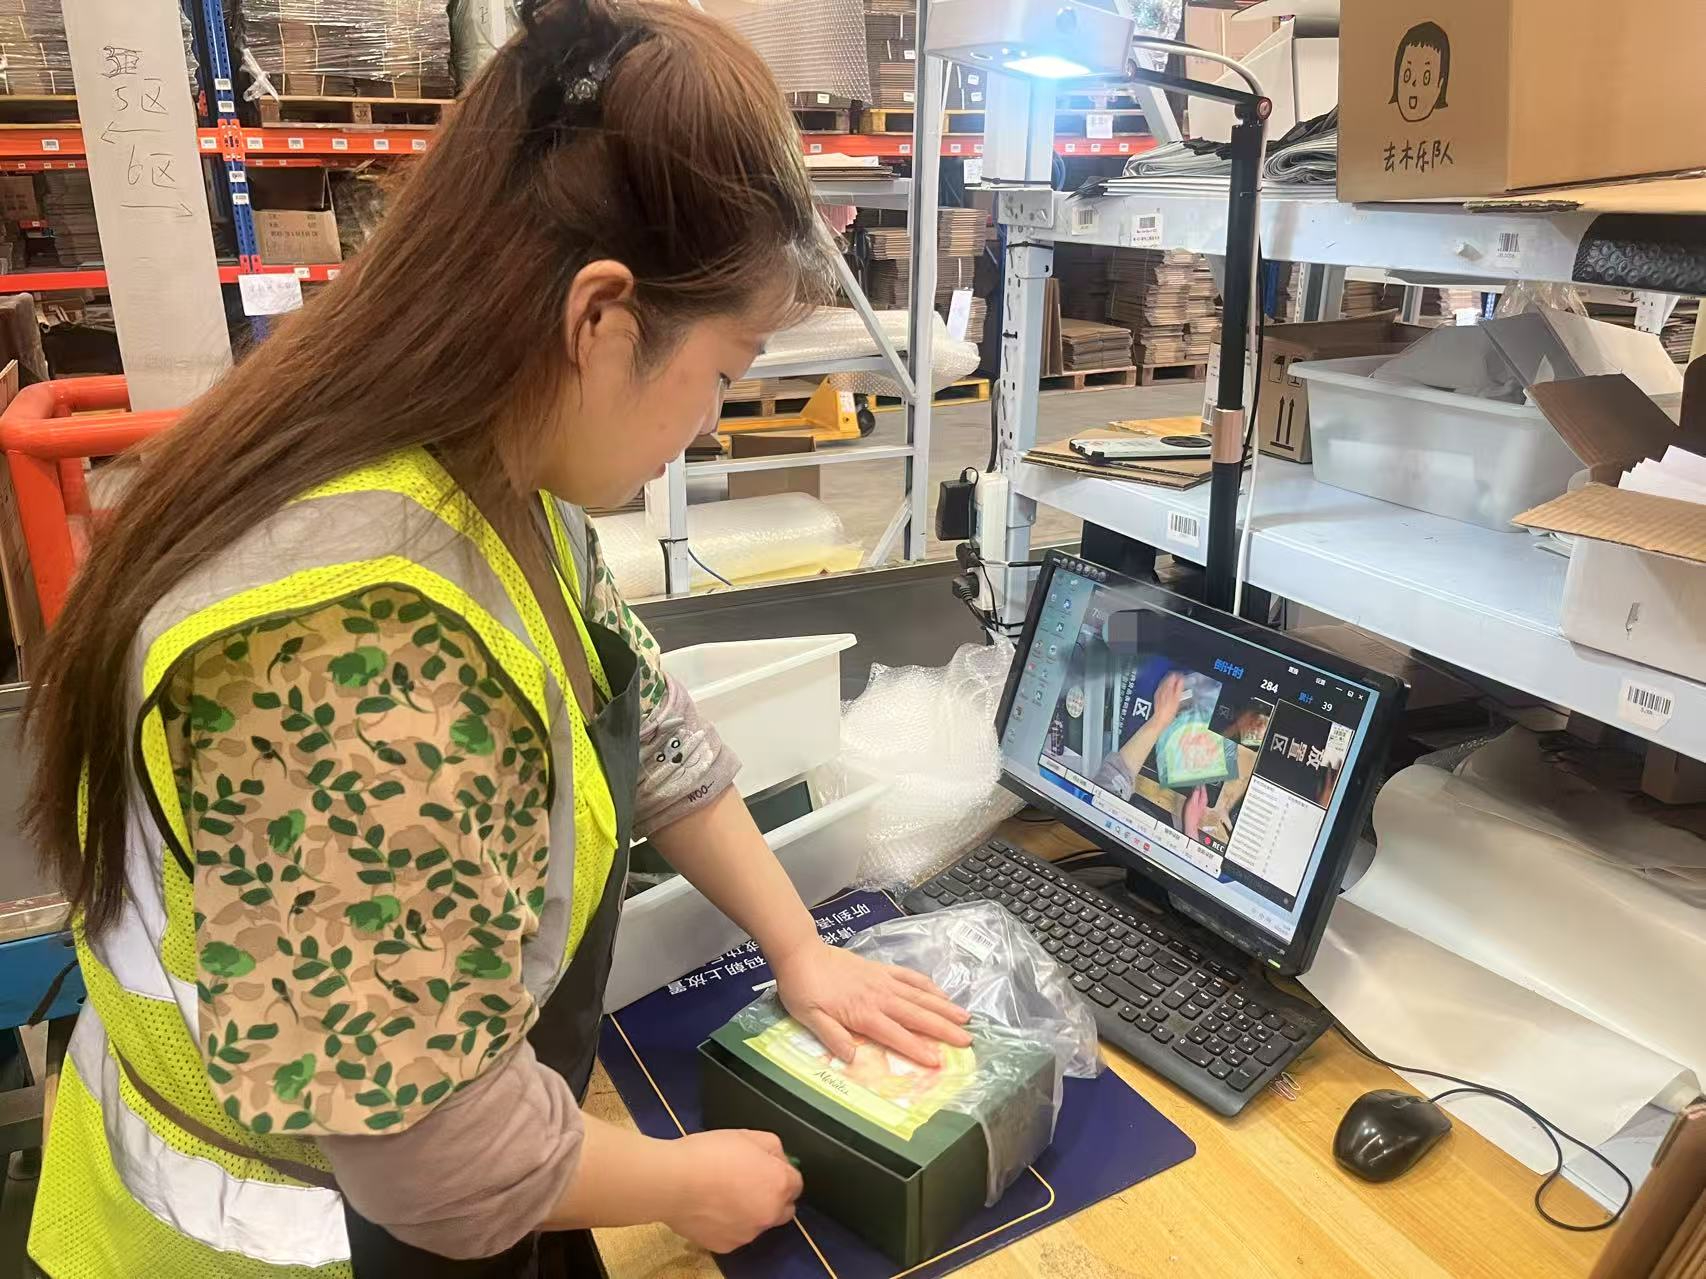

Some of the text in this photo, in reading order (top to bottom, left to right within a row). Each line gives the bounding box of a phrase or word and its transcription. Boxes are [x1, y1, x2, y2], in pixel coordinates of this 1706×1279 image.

[115, 78, 169, 115] 5区
[128, 145, 177, 190] 6区
[1383, 139, 1454, 173] 去木乐队
[1214, 658, 1279, 694] 倒计时 284
[1321, 701, 1333, 712] 39
[1270, 732, 1325, 770] 放置区
